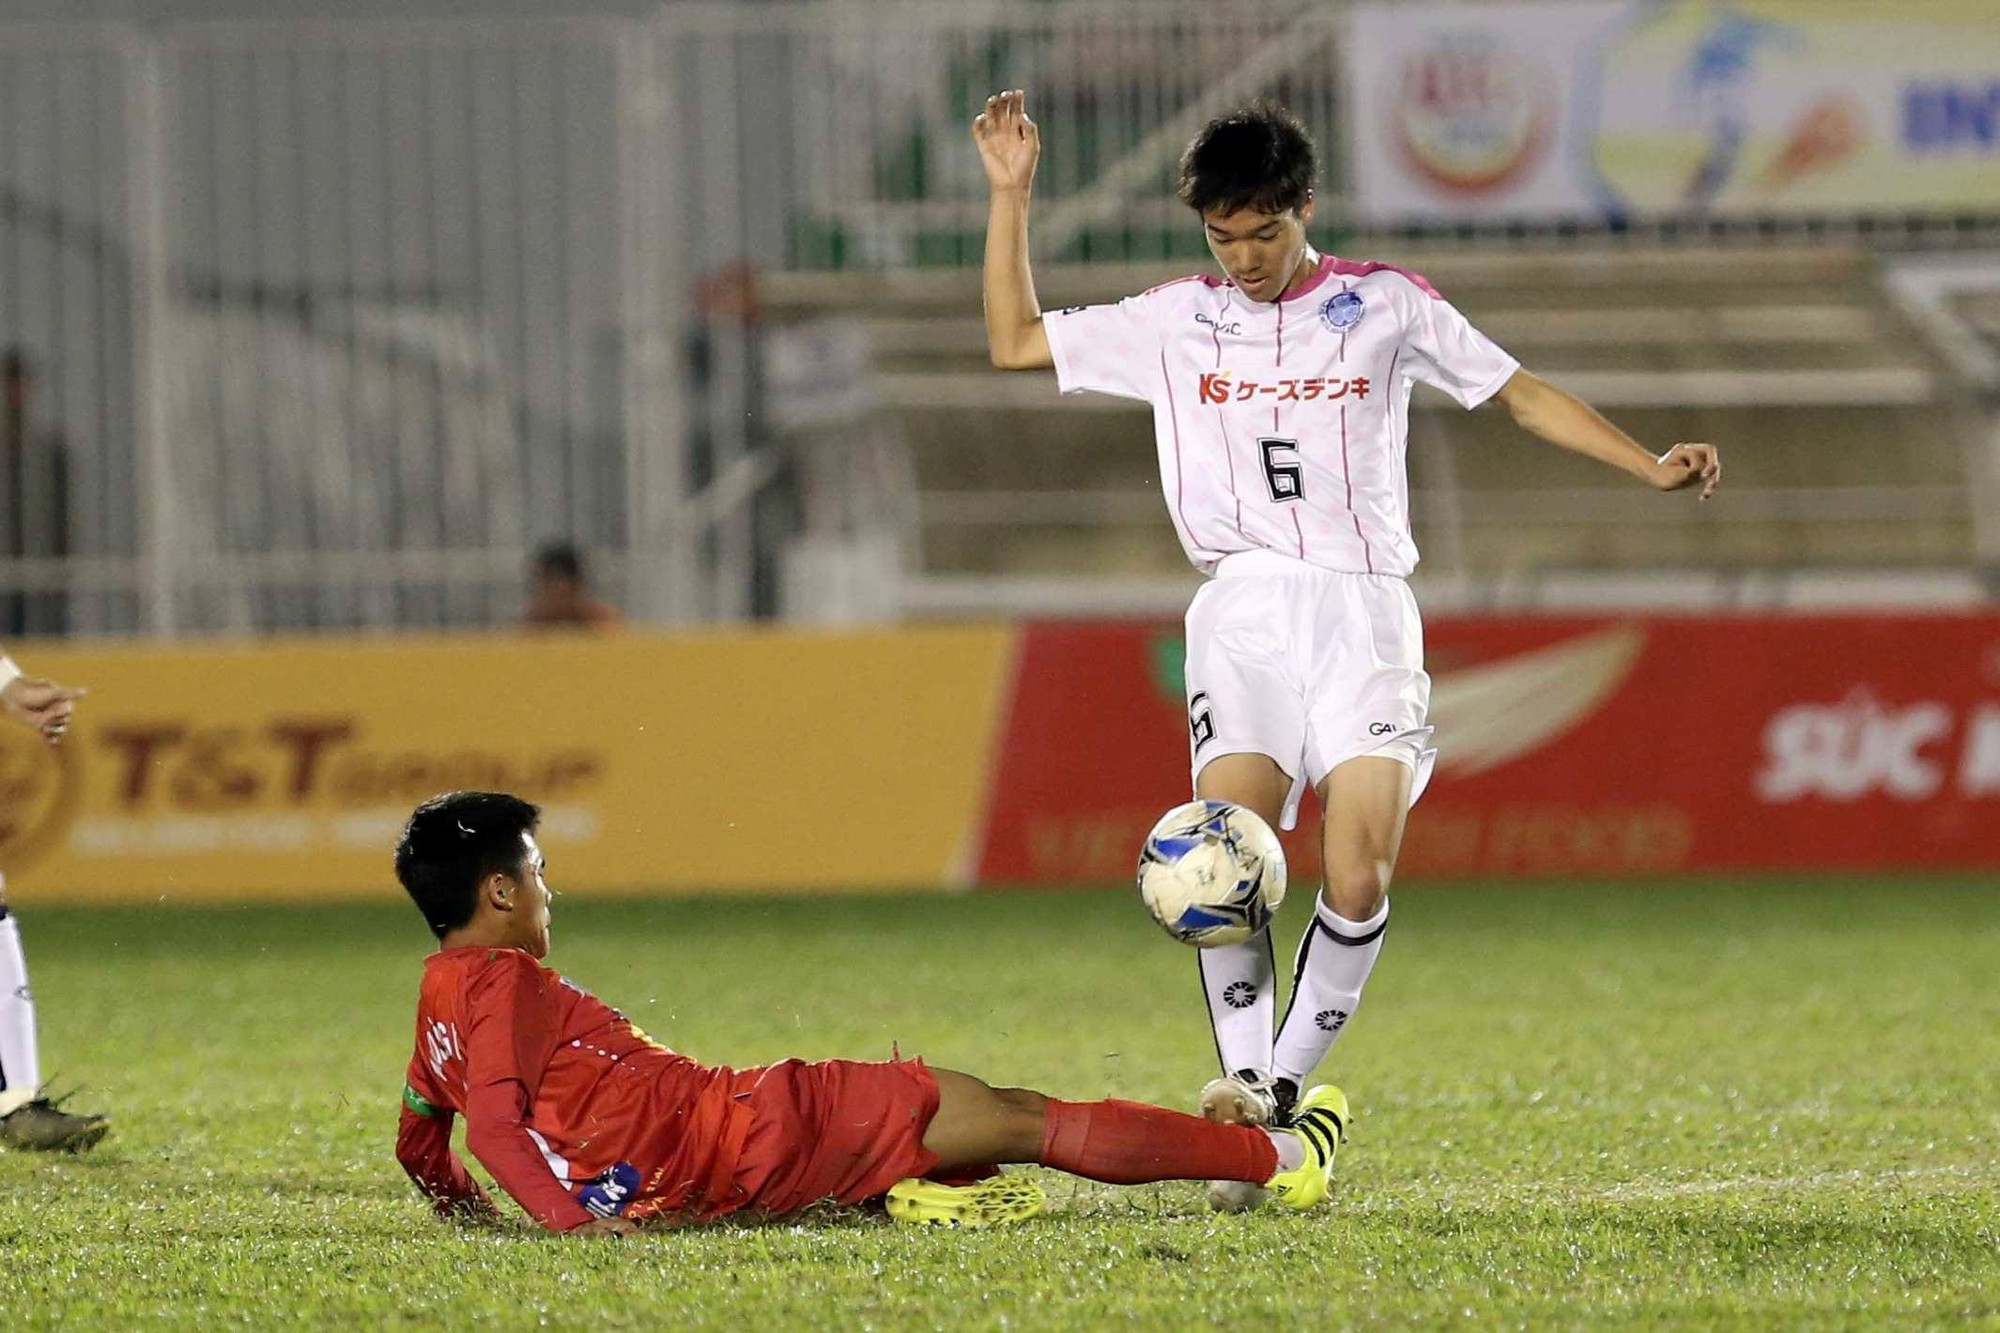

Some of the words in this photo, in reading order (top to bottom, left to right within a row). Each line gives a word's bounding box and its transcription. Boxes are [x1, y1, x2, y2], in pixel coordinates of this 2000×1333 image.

[1236, 377, 1370, 401] ケーズデンキ
[1256, 437, 1306, 503] 6
